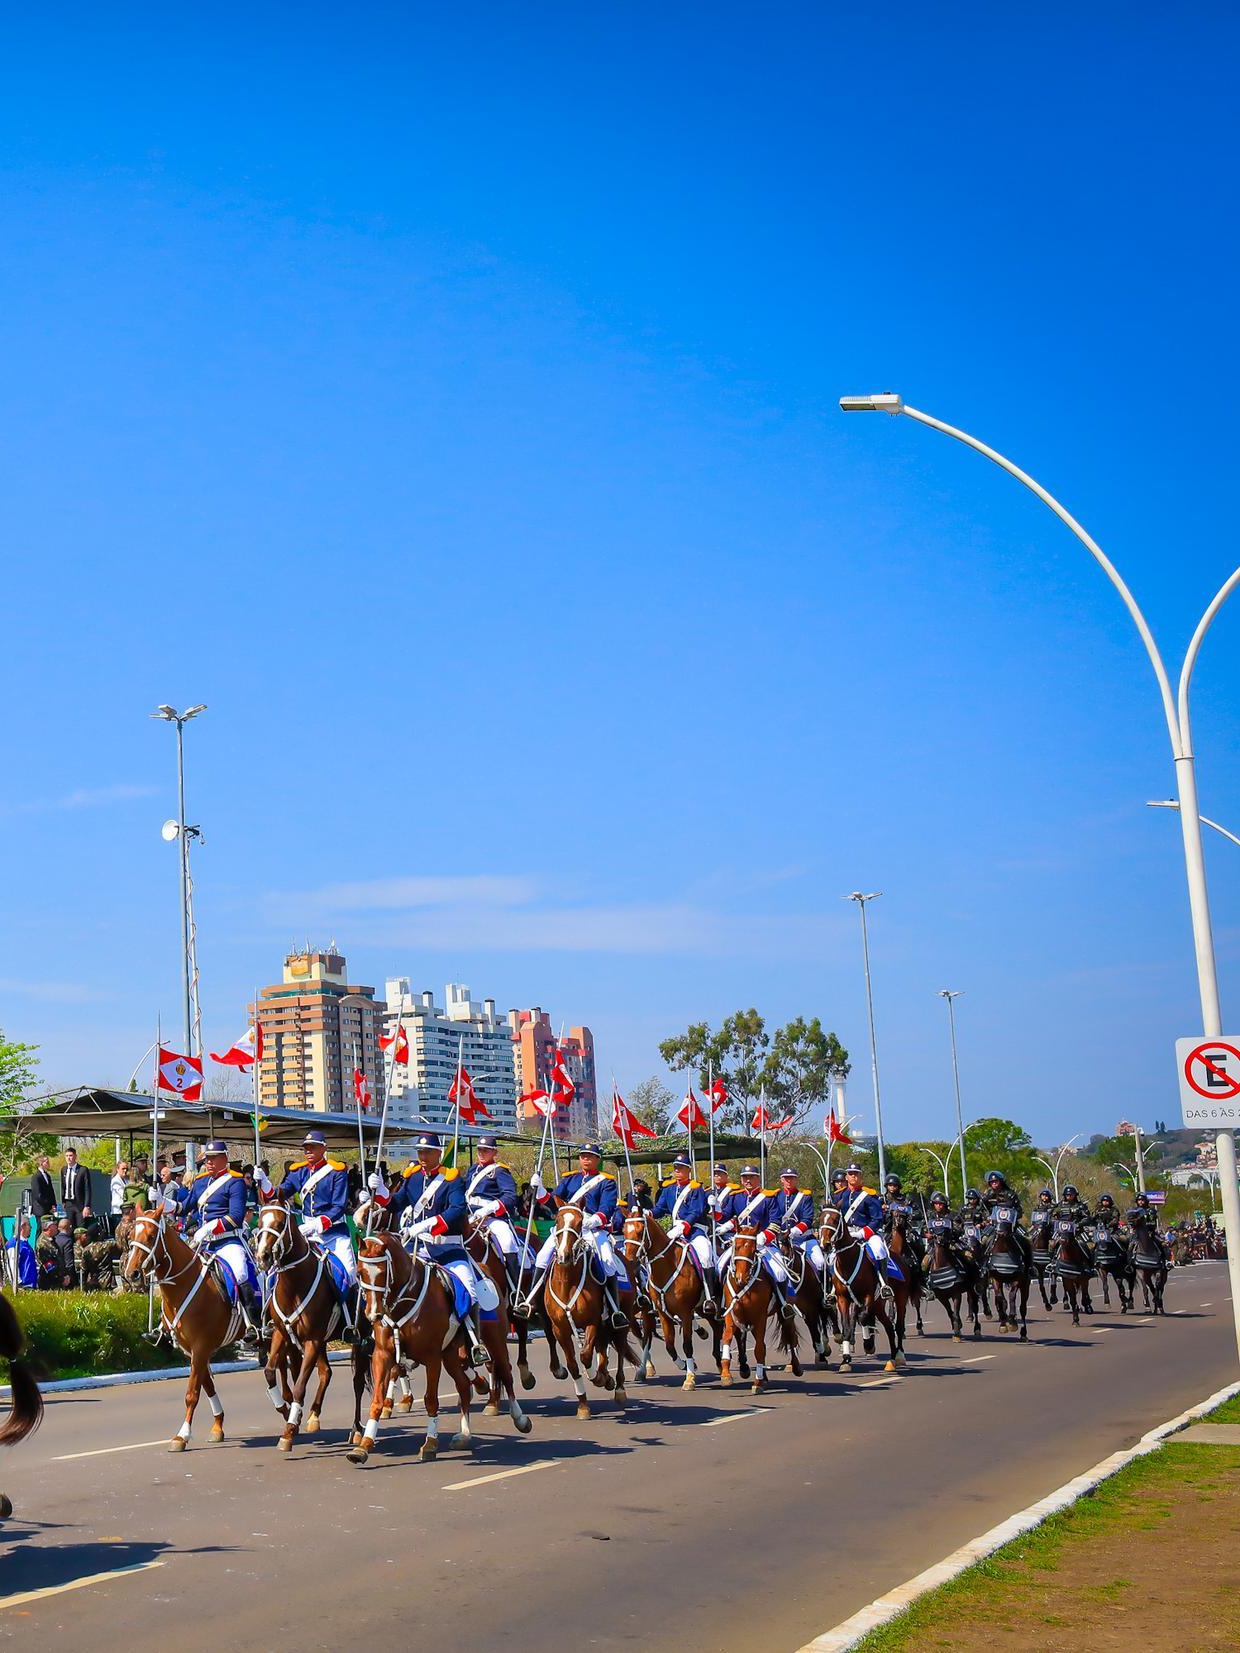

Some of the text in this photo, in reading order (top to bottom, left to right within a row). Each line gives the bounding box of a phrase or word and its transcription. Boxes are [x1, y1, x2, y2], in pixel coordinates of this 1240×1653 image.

[1205, 1054, 1229, 1087] E
[176, 1078, 183, 1088] 2
[1186, 1110, 1208, 1119] DAS
[1211, 1109, 1218, 1118] 6
